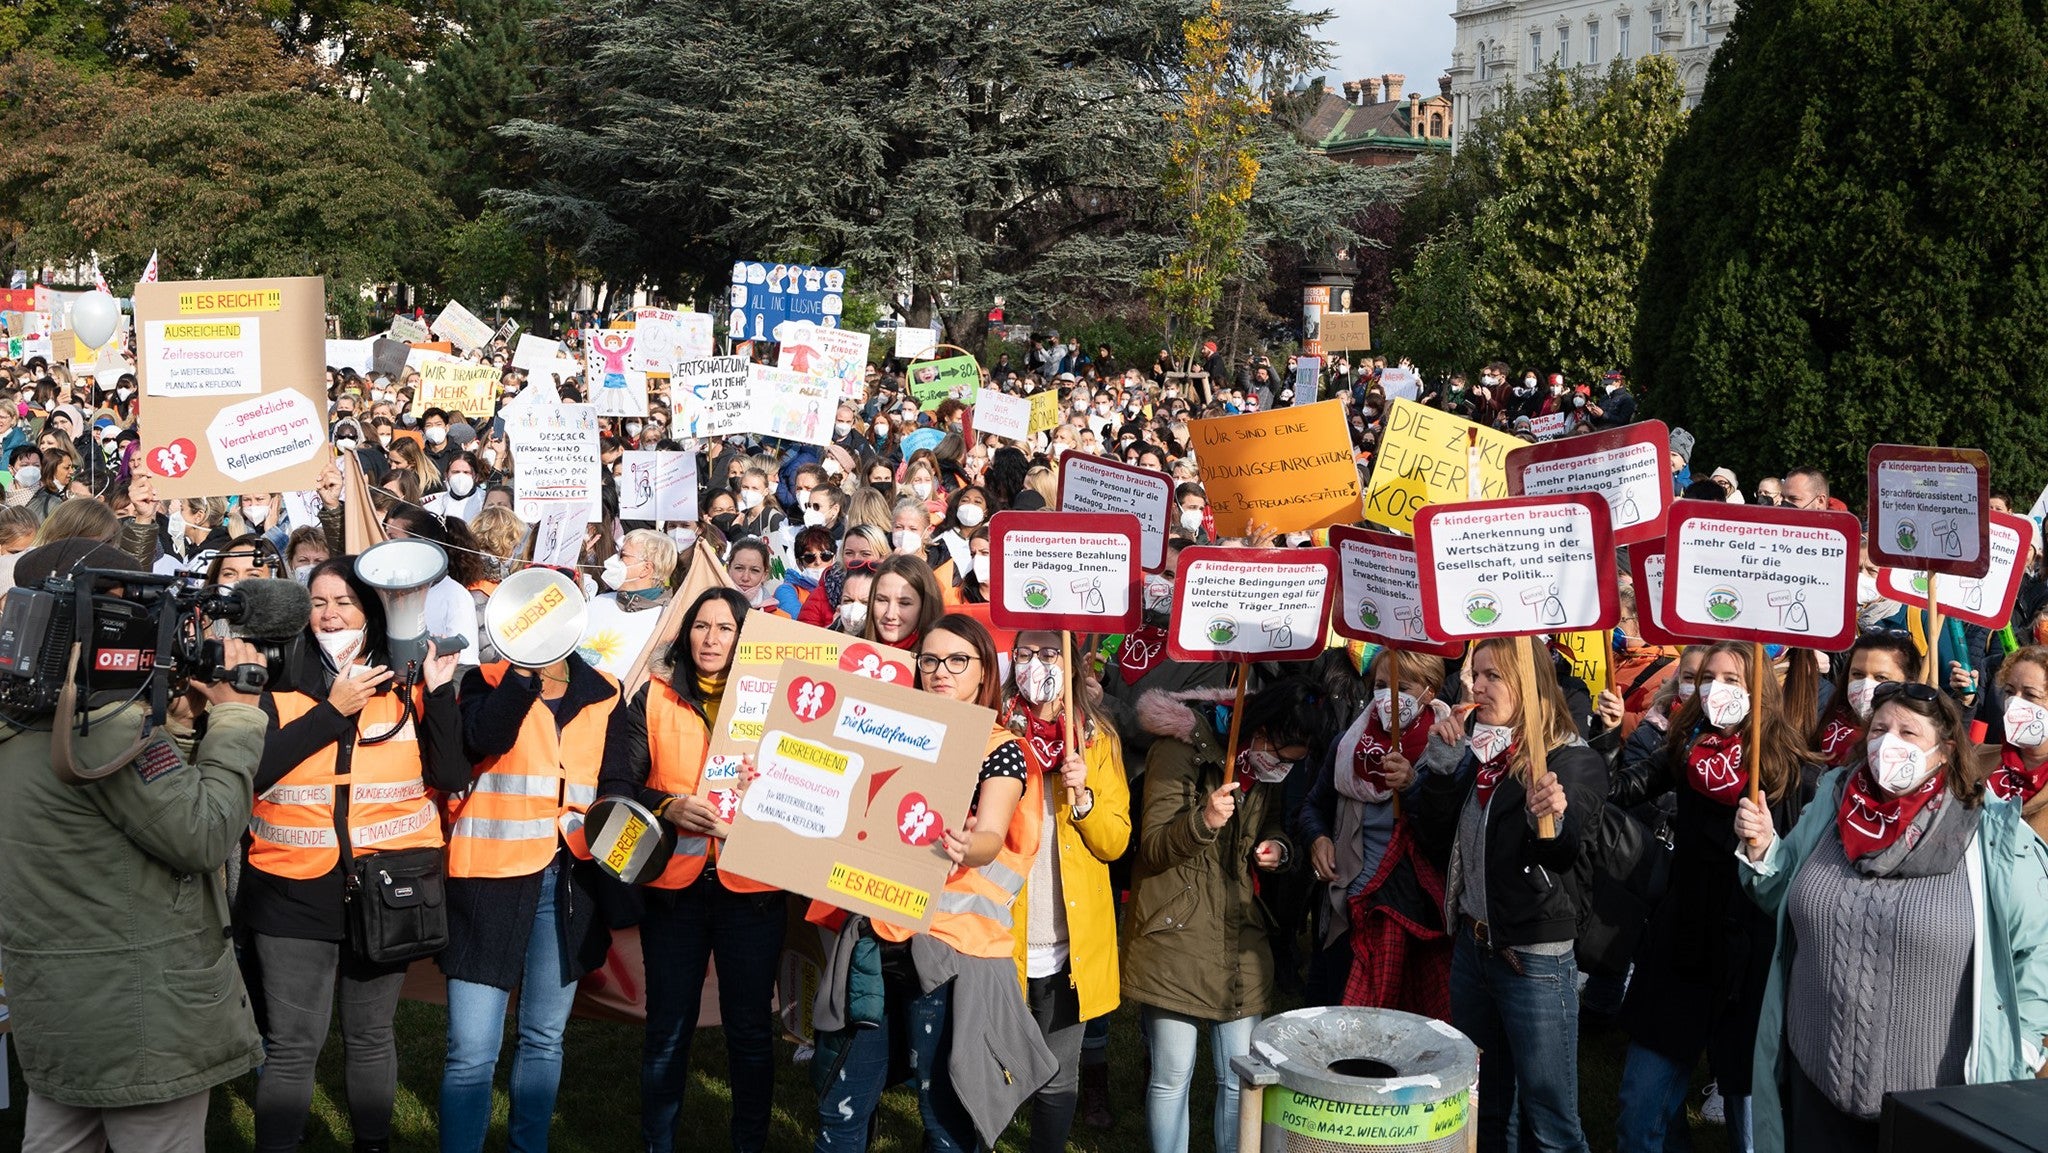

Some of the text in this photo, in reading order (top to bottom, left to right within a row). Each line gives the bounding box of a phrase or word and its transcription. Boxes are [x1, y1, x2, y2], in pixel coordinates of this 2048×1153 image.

[197, 295, 214, 309] ES
[218, 293, 265, 308] REICHT
[751, 295, 765, 310] ALL
[638, 310, 657, 320] MEHR
[660, 311, 674, 322] ZEIT
[164, 325, 241, 338] AUSREICHEND
[1325, 320, 1355, 330] ES IST
[162, 347, 244, 360] Zeitressourcen
[824, 343, 829, 352] 7
[831, 345, 858, 356] KINDER
[425, 365, 501, 381] WIR BRAUCHEN
[165, 381, 198, 390] PLANUNG
[205, 380, 242, 389] REFLEXION
[712, 378, 723, 388] IST
[433, 385, 468, 398] MEHR
[711, 389, 729, 401] ALS
[1030, 396, 1046, 411] EHR
[236, 398, 294, 427] gesetzliche
[718, 419, 733, 429] LOB
[1275, 422, 1309, 436] EINE
[1391, 405, 1433, 442] DIE
[219, 417, 309, 449] Verankerung von
[1379, 443, 1467, 492] EURER
[1525, 445, 1656, 475] # kindergarten braucht...
[1079, 462, 1125, 481] kindergarten
[1126, 475, 1163, 490] braucht...
[1526, 458, 1656, 489] ...mehr Planungsstunden
[1888, 462, 1937, 473] kindergarten
[1938, 465, 1977, 475] braucht...
[1074, 474, 1159, 501] ...mehr Personal für die
[1915, 478, 1939, 487] ...eine
[1092, 489, 1122, 503] Gruppen
[1131, 499, 1136, 507] 2
[1368, 482, 1436, 522] KOS
[1880, 488, 1978, 504] Sprachförderassistent_In
[1882, 501, 1977, 516] für jeden Kindergarten...
[1432, 507, 1590, 526] # kindergarten braucht...
[1450, 524, 1573, 541] ...Anerkennung und
[1687, 521, 1841, 542] # kindergarten braucht...
[1990, 529, 2018, 542] ucht...
[1015, 535, 1077, 546] kindergarten
[1080, 537, 1127, 546] braucht...
[1446, 538, 1580, 556] Wertschätzung in der
[1683, 538, 1725, 549] ...mehr
[1729, 540, 1756, 551] Geld
[1771, 544, 1792, 554] 1%
[1795, 545, 1818, 556] des
[1821, 547, 1844, 558] BIP
[1005, 549, 1127, 562] ...eine bessere Bezahlung
[1348, 543, 1397, 560] kindergarten
[1991, 542, 2016, 555] Innen
[1013, 561, 1117, 573] der Pädagog_Innen...
[1206, 562, 1274, 574] kindergarten
[1277, 565, 1324, 573] braucht...
[1348, 558, 1416, 578] ...Neuberechnung
[1437, 552, 1593, 572] Gesellschaft, und seitens
[1741, 554, 1781, 567] für die
[1990, 555, 2012, 566] rten-
[1187, 576, 1326, 588] ...gleiche Bedingungen und
[1477, 570, 1554, 583] der Politik...
[1693, 565, 1830, 586] Elementarpädagogik...
[544, 587, 564, 607] ES
[1192, 587, 1320, 600] Unterstützungen egal für
[1366, 583, 1414, 601] Schlüssels...
[1192, 600, 1316, 612] welche Träger_Innen...
[99, 652, 137, 666] ORF
[755, 646, 771, 660] ES
[777, 645, 822, 660] REICHT
[1573, 660, 1598, 681] EN
[740, 680, 776, 694] NEUDE
[739, 702, 770, 715] der T
[731, 723, 763, 737] ASSIS
[841, 714, 937, 751] Die Kinderfreunde
[778, 739, 848, 772] AUSREICHEND
[707, 766, 723, 778] Die
[766, 762, 840, 799] Zeitressourcen
[767, 789, 776, 800] für
[757, 803, 826, 834] PLANUNG & REFLEXION
[260, 825, 327, 845] USREICHENDE
[608, 815, 645, 868] ES REICHT
[845, 872, 865, 892] ES
[865, 878, 914, 908] REICHT
[1293, 1092, 1410, 1117] GARTENTELEFON
[1282, 1110, 1419, 1138] POST@MA42.WIEN.GV.AT
